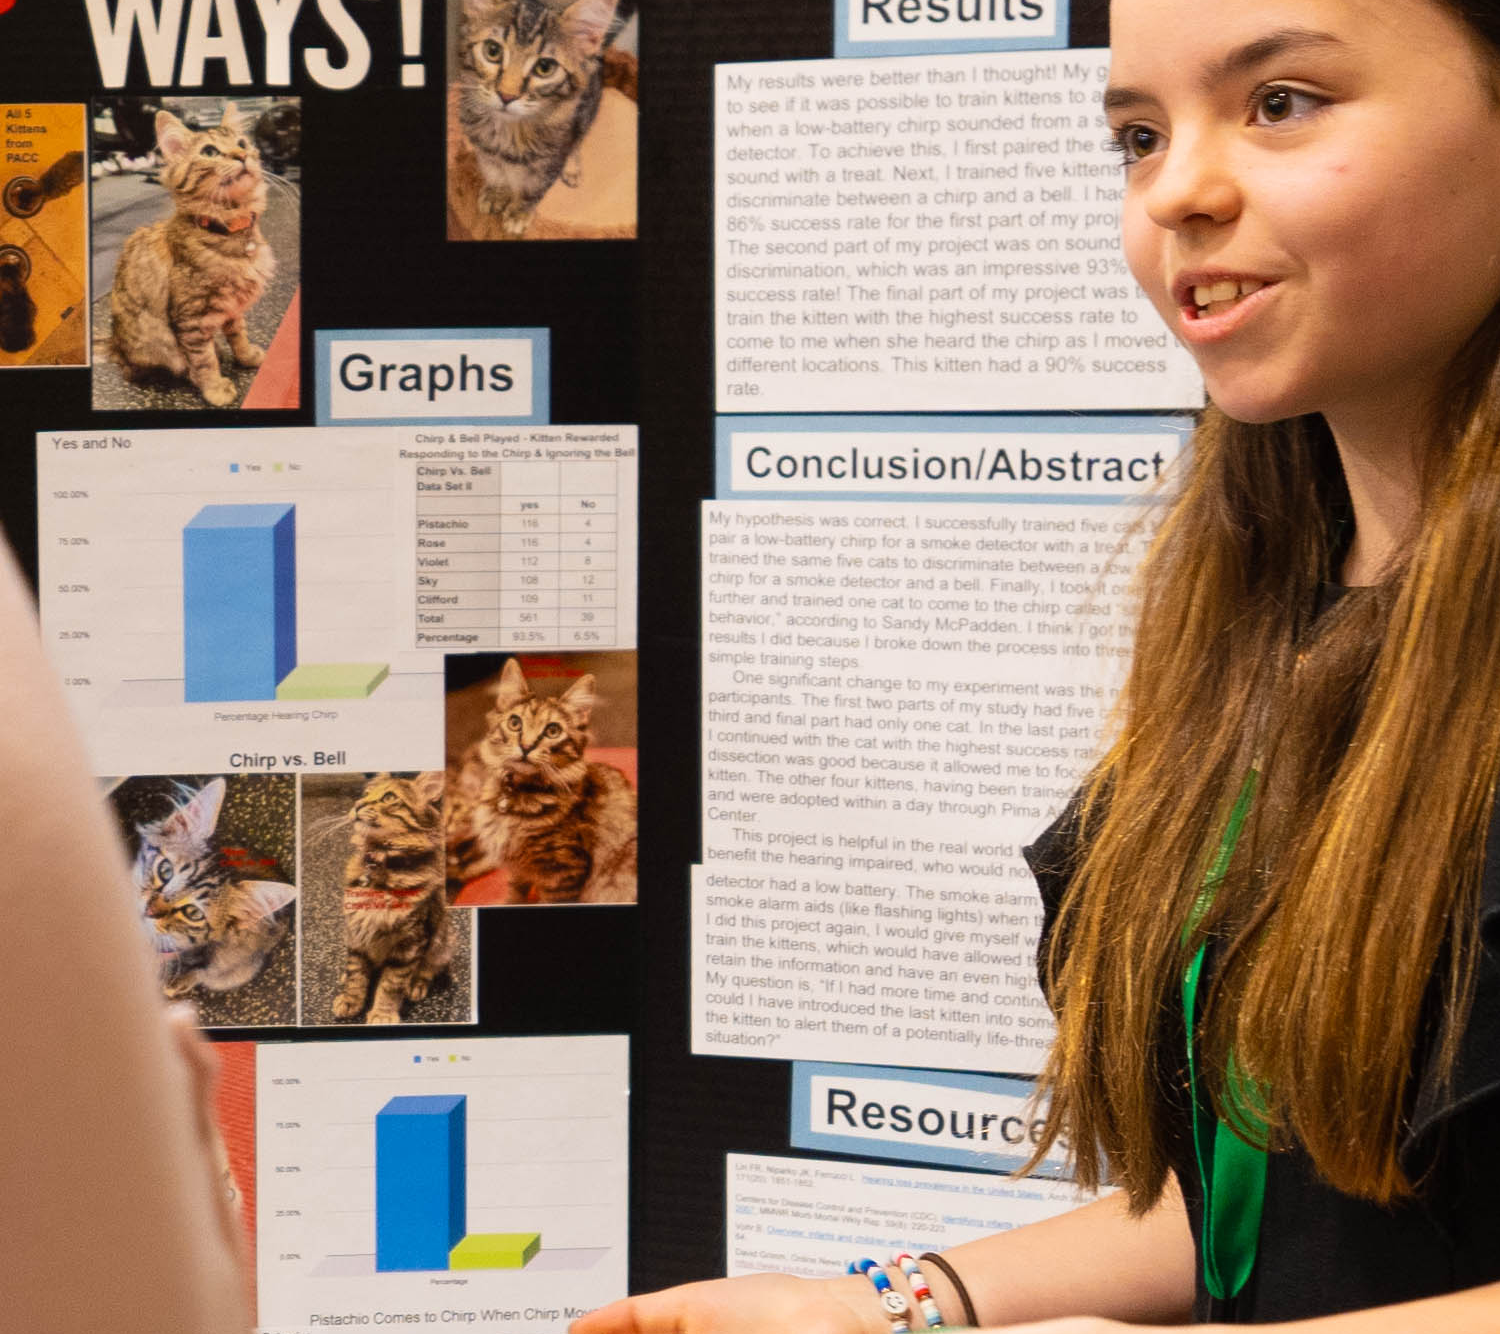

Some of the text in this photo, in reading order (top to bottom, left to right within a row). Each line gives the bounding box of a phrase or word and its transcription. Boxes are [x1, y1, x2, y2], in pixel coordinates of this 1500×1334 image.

[727, 63, 1090, 92] My results were better than I thought! My
[25, 109, 32, 118] 5
[7, 124, 47, 133] Kittens
[6, 139, 33, 148] from
[7, 153, 39, 162] PACC
[727, 309, 1138, 328] train the kitten with the highest success rate to
[726, 356, 797, 372] different
[891, 355, 928, 372] This
[934, 357, 982, 372] kitten
[988, 356, 1022, 373] had
[1027, 359, 1039, 373] a
[1045, 355, 1085, 372] 90%
[1091, 359, 1167, 373] success
[339, 352, 514, 401] Graphs
[52, 436, 132, 449] Yes and No
[468, 450, 480, 459] to
[482, 450, 498, 459] the
[594, 447, 611, 457] the
[746, 446, 1164, 485] Conclusion/Abstract
[417, 482, 442, 491] Data
[444, 482, 463, 491] Set
[520, 500, 596, 511] yes No
[417, 519, 469, 529] Pistachio
[709, 510, 732, 527] My
[735, 512, 815, 527] hypothesis
[819, 516, 849, 527] was
[915, 514, 920, 528] I
[924, 516, 1017, 533] successfully
[1021, 519, 1076, 531] trained
[1080, 518, 1108, 532] five
[417, 539, 446, 548] Rose
[417, 558, 449, 567] Violet
[417, 576, 439, 587] Sky
[417, 595, 458, 605] Clifford
[417, 614, 445, 623] Total
[786, 614, 858, 631] according
[863, 616, 877, 628] to
[882, 615, 930, 633] Sandy
[1027, 620, 1032, 632] I
[1037, 621, 1074, 634] think
[417, 632, 479, 643] Percentage
[214, 710, 338, 722] Percentage Hearing Chirp
[229, 751, 346, 769] Chirp vs. Bell
[705, 1010, 982, 1046] the kitten to alert them of a potentially
[310, 1314, 370, 1325] Pistachio
[373, 1311, 421, 1324] Comes
[424, 1312, 437, 1322] to
[440, 1309, 477, 1323] Chirp
[480, 1309, 520, 1320] When
[523, 1307, 560, 1321] Chirp
